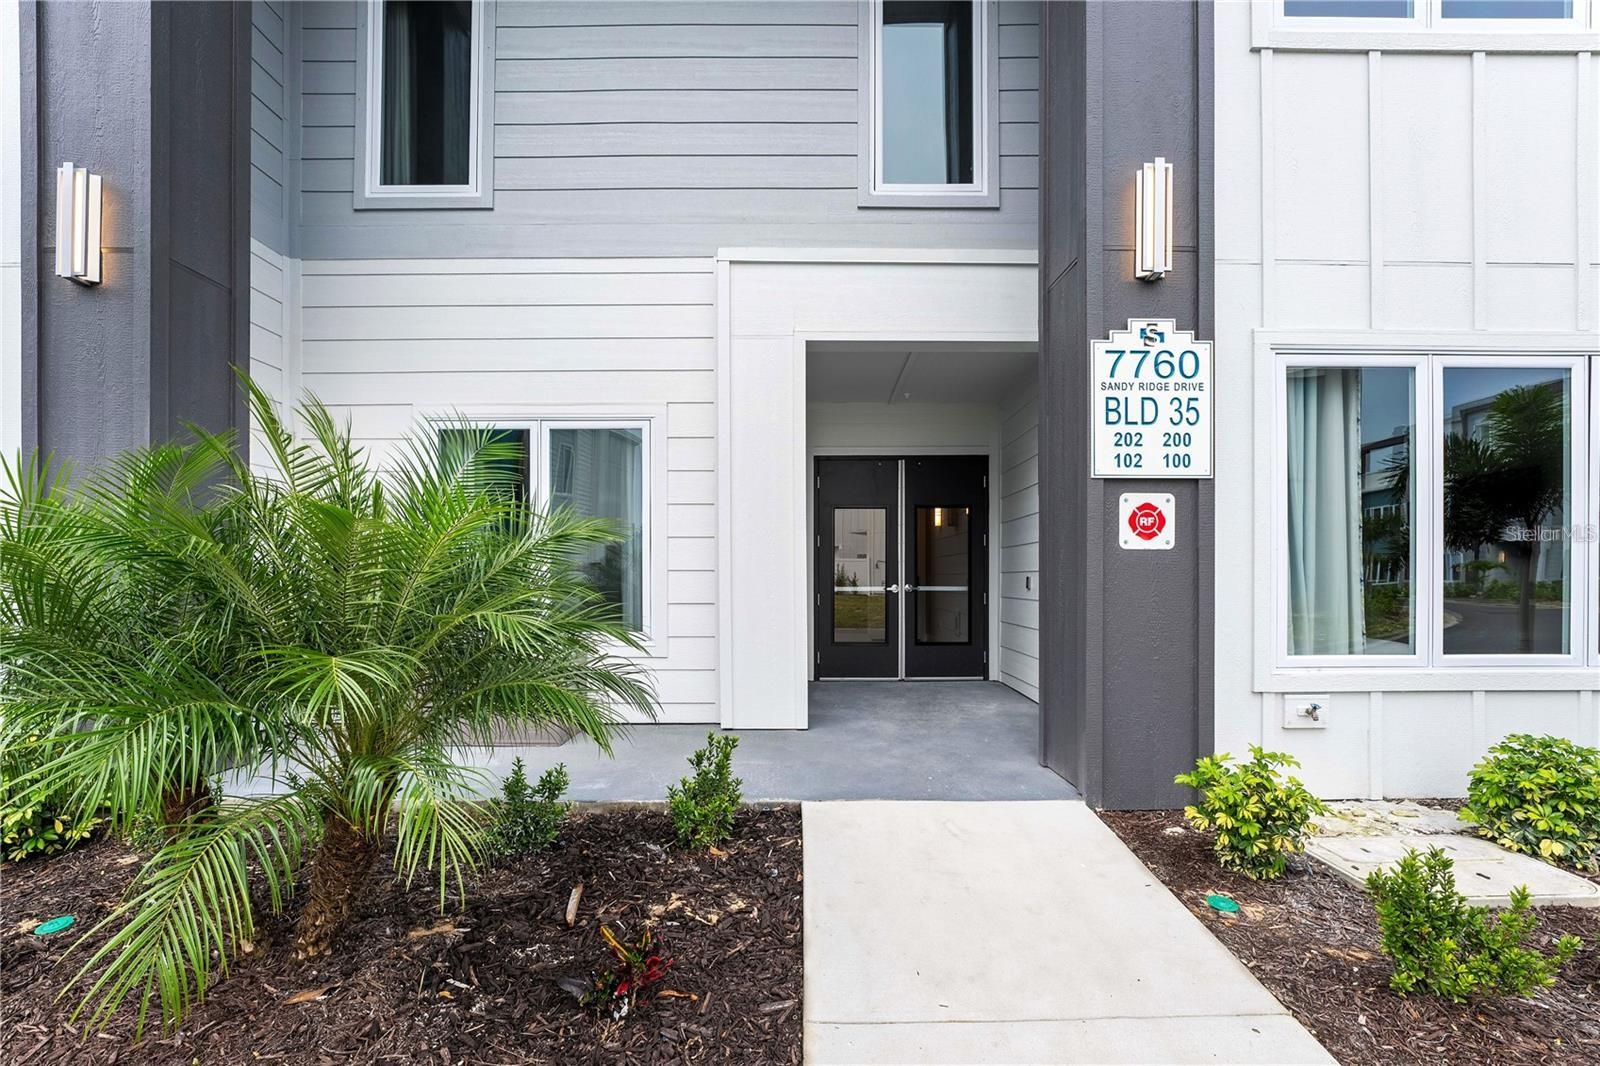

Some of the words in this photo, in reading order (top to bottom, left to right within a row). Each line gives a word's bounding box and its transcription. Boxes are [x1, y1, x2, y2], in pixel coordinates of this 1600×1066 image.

[1105, 350, 1200, 379] 7760
[1100, 382, 1135, 391] SANDY
[1138, 382, 1170, 391] RIDGE
[1174, 382, 1205, 391] DRIVE
[1105, 396, 1159, 425] BLD
[1169, 397, 1200, 426] 35
[1113, 432, 1143, 447] 202
[1163, 432, 1192, 447] 200
[1113, 453, 1143, 468] 102
[1163, 453, 1191, 468] 100
[1139, 516, 1156, 527] RF
